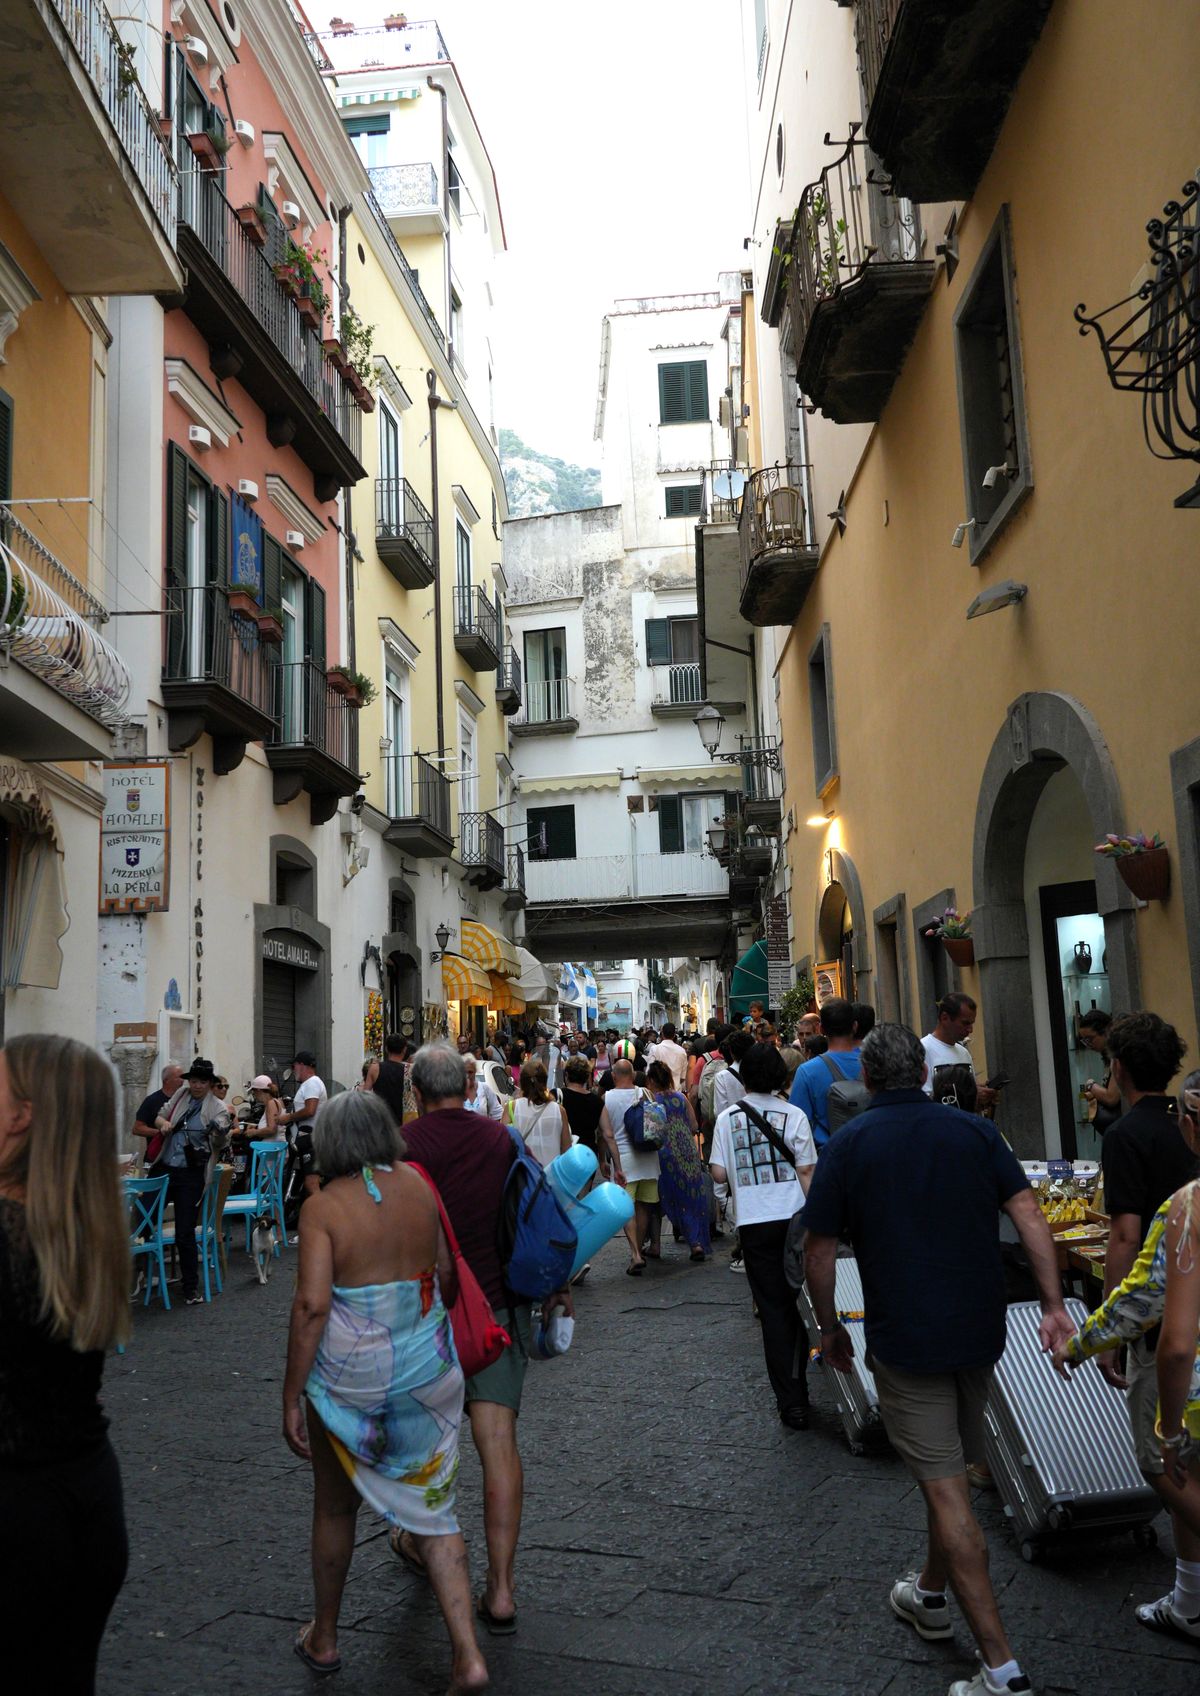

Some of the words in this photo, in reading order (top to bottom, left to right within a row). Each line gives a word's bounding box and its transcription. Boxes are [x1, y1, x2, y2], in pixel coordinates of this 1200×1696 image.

[111, 776, 156, 787] HOTEL
[105, 813, 163, 826] AMALFI
[106, 835, 162, 847] RISTORANTE
[104, 882, 120, 894] LA
[125, 881, 161, 894] PERLA
[263, 938, 286, 960] HOTEL
[287, 944, 310, 966] AMALFI
